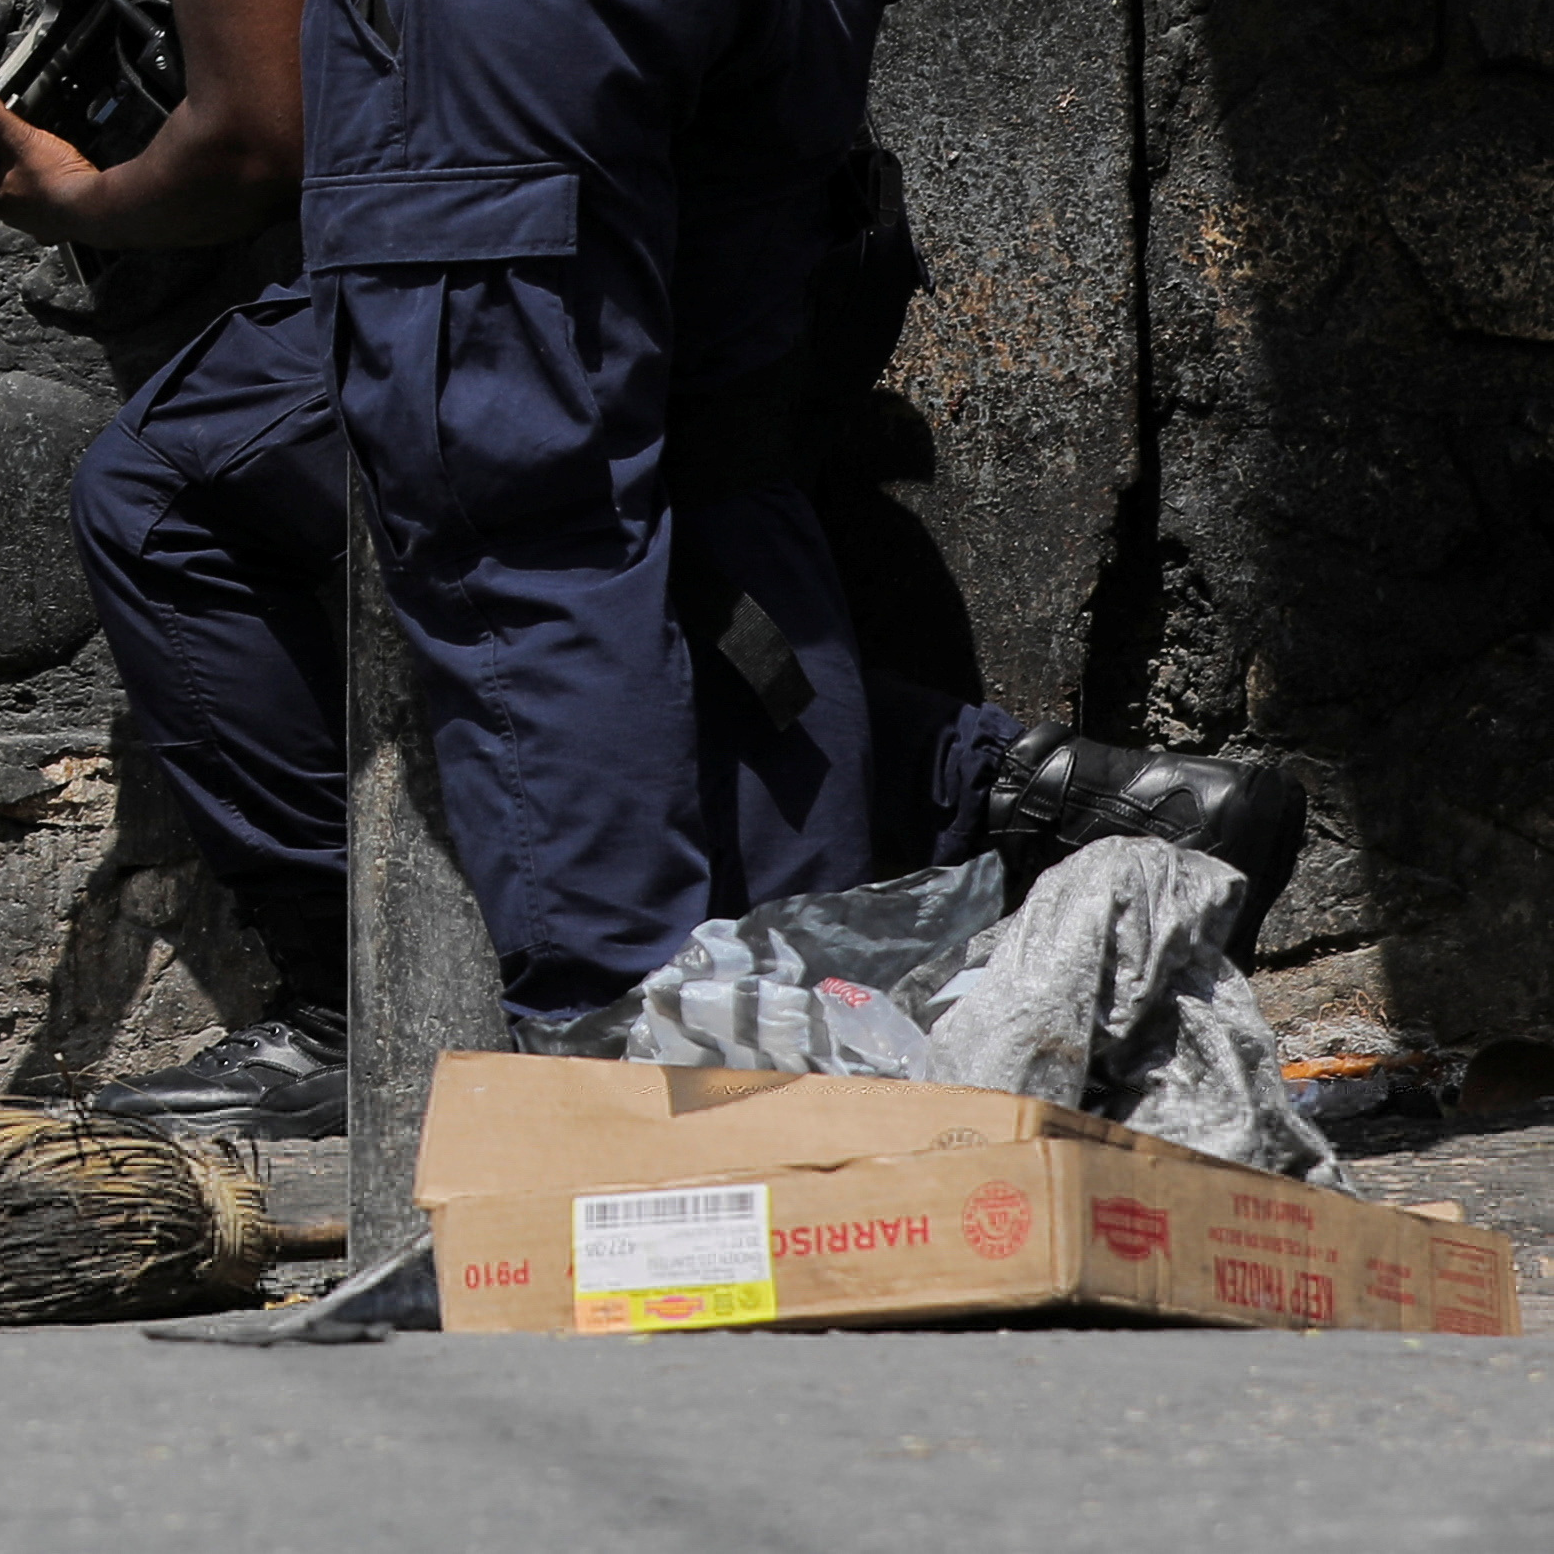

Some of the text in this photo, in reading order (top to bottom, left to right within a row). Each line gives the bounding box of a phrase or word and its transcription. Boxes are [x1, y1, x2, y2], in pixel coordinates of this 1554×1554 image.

[464, 1259, 530, 1288] P910
[1214, 1256, 1286, 1313] FROZEN
[1290, 1269, 1334, 1322] KEEP
